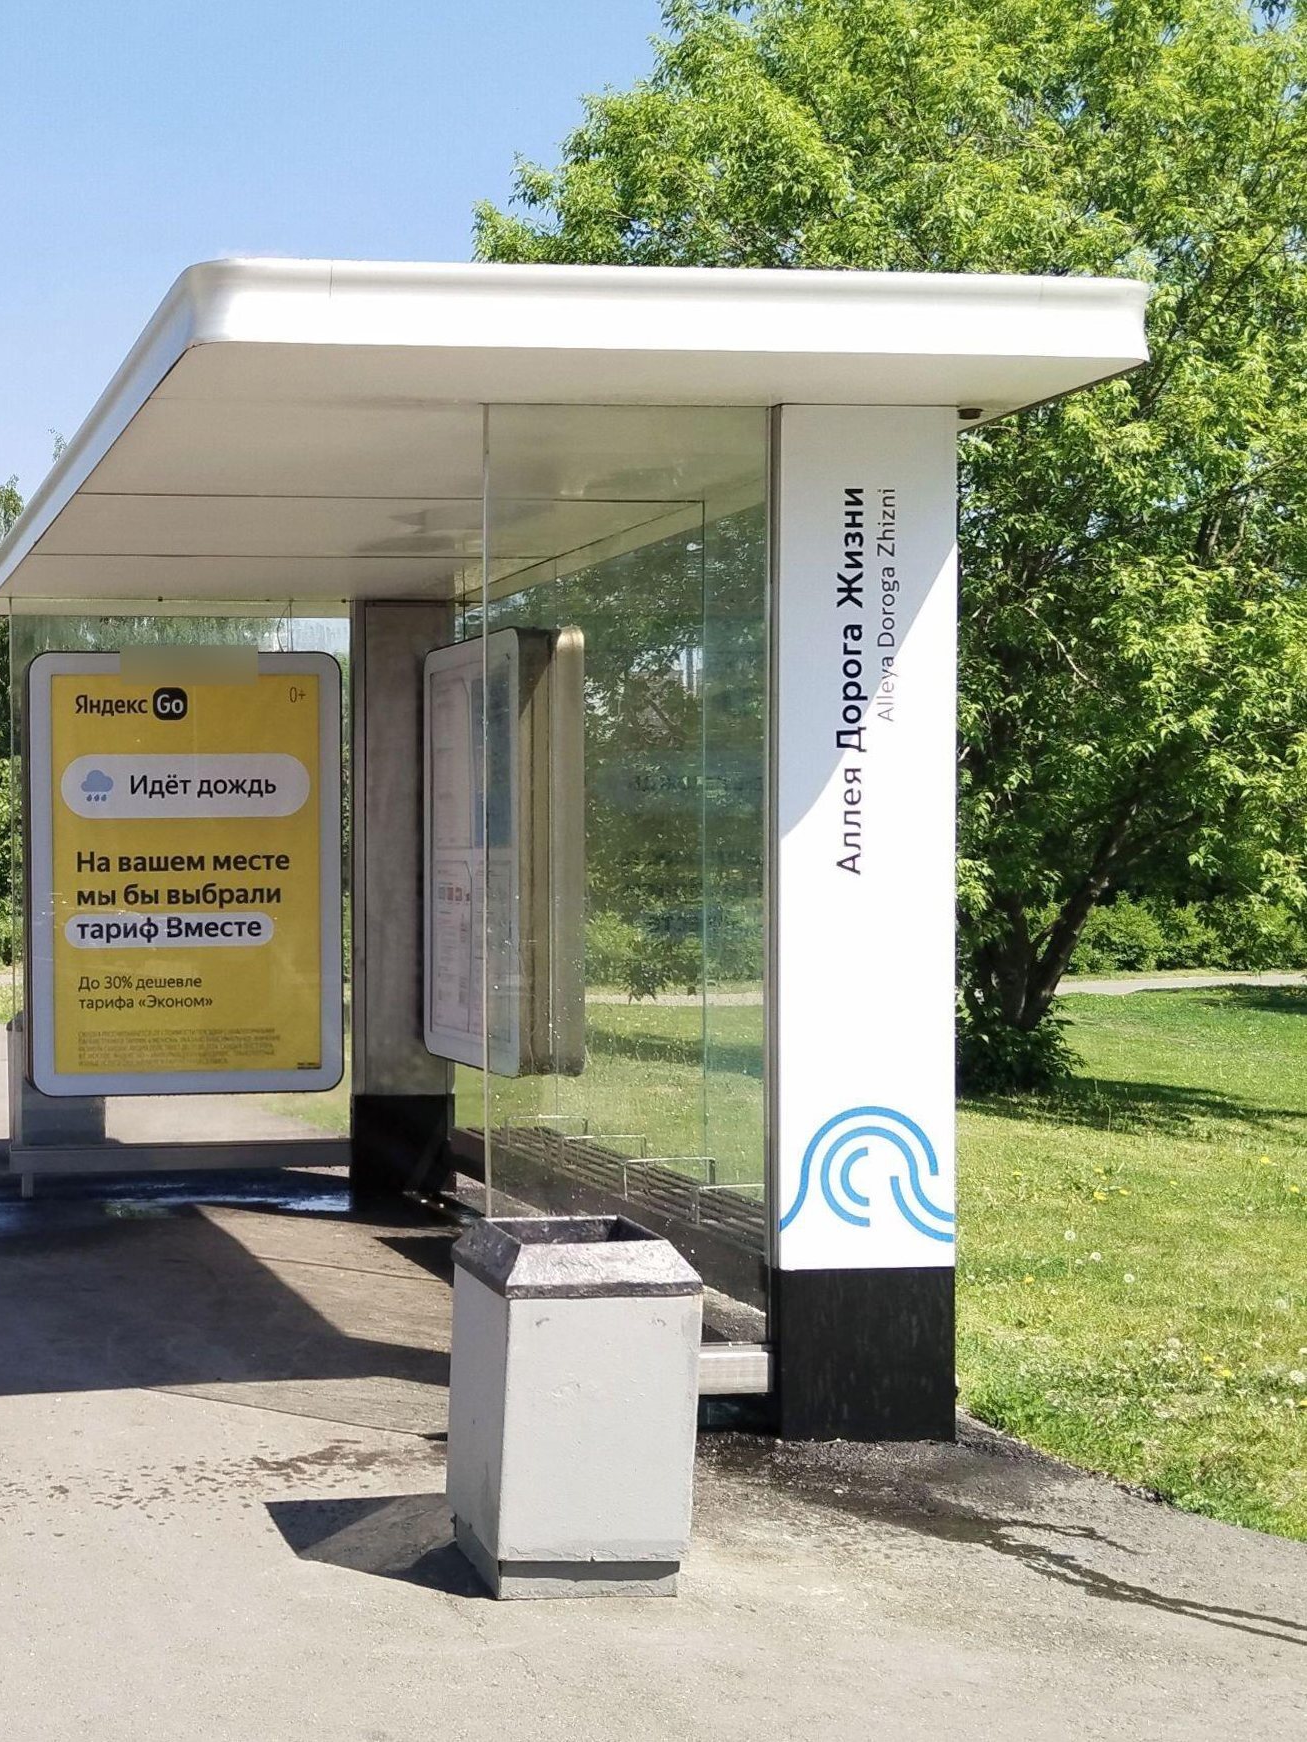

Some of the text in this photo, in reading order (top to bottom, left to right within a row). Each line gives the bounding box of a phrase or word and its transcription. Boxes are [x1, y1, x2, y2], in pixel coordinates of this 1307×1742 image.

[876, 488, 900, 722] Alleya Doroga Zhizni
[836, 488, 868, 875] Аллея Дорога Жизни
[75, 693, 184, 716] Яндекс Go
[130, 774, 276, 800] Идёт дождь
[77, 851, 290, 872] На вашем месте
[77, 883, 281, 908] мы бы выбрали
[77, 916, 262, 943] тариф Вместе
[78, 975, 202, 992] До 30% дешевле
[79, 994, 213, 1011] тарифа «Эконом»
